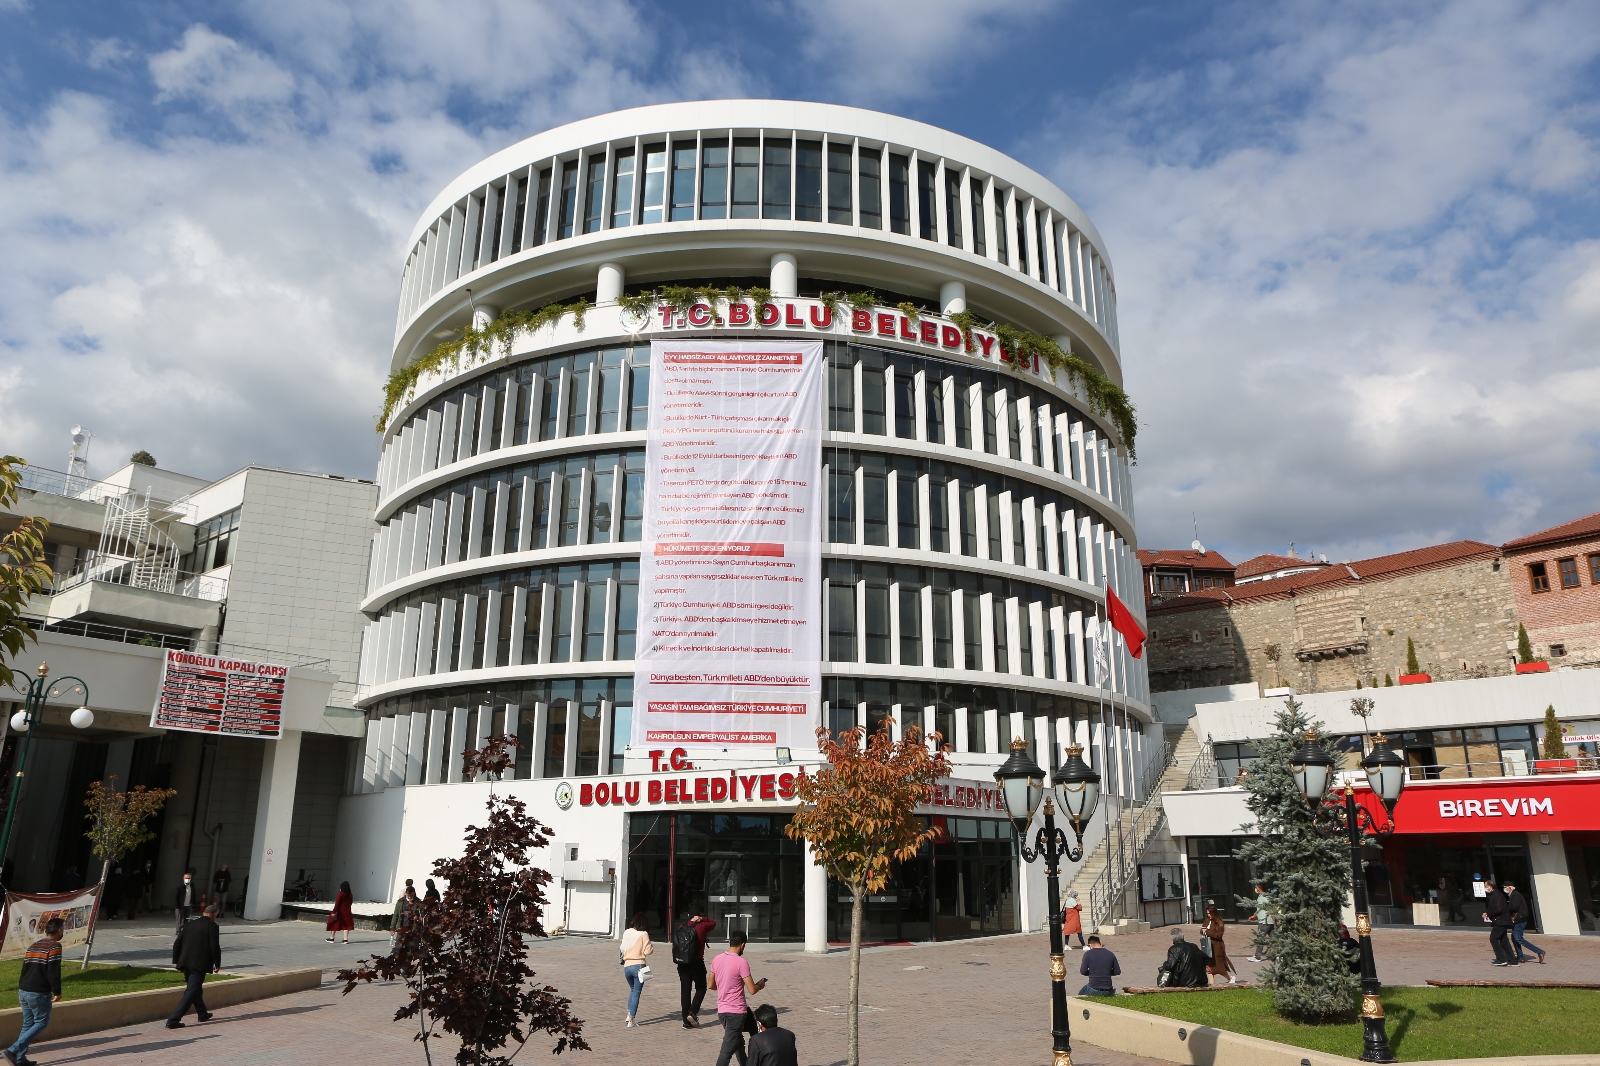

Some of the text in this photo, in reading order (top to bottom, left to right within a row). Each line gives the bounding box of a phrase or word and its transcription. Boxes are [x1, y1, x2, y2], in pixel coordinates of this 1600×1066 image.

[167, 651, 216, 668] KÖROĞLU
[218, 659, 256, 673] KAPALI
[257, 665, 287, 679] ÇARŞI
[650, 674, 674, 682] Dünya
[703, 674, 720, 683] Türk
[720, 674, 743, 683] milleti
[743, 674, 775, 683] ABD'den
[775, 675, 811, 683] büyüktür.
[649, 703, 678, 711] YAŞASIN
[727, 704, 757, 712] TÜRKİYE
[756, 704, 804, 712] CUMHURİYETİ
[740, 733, 772, 741] AMERİKA
[649, 747, 693, 772] T.C.
[580, 781, 640, 806] BOLU
